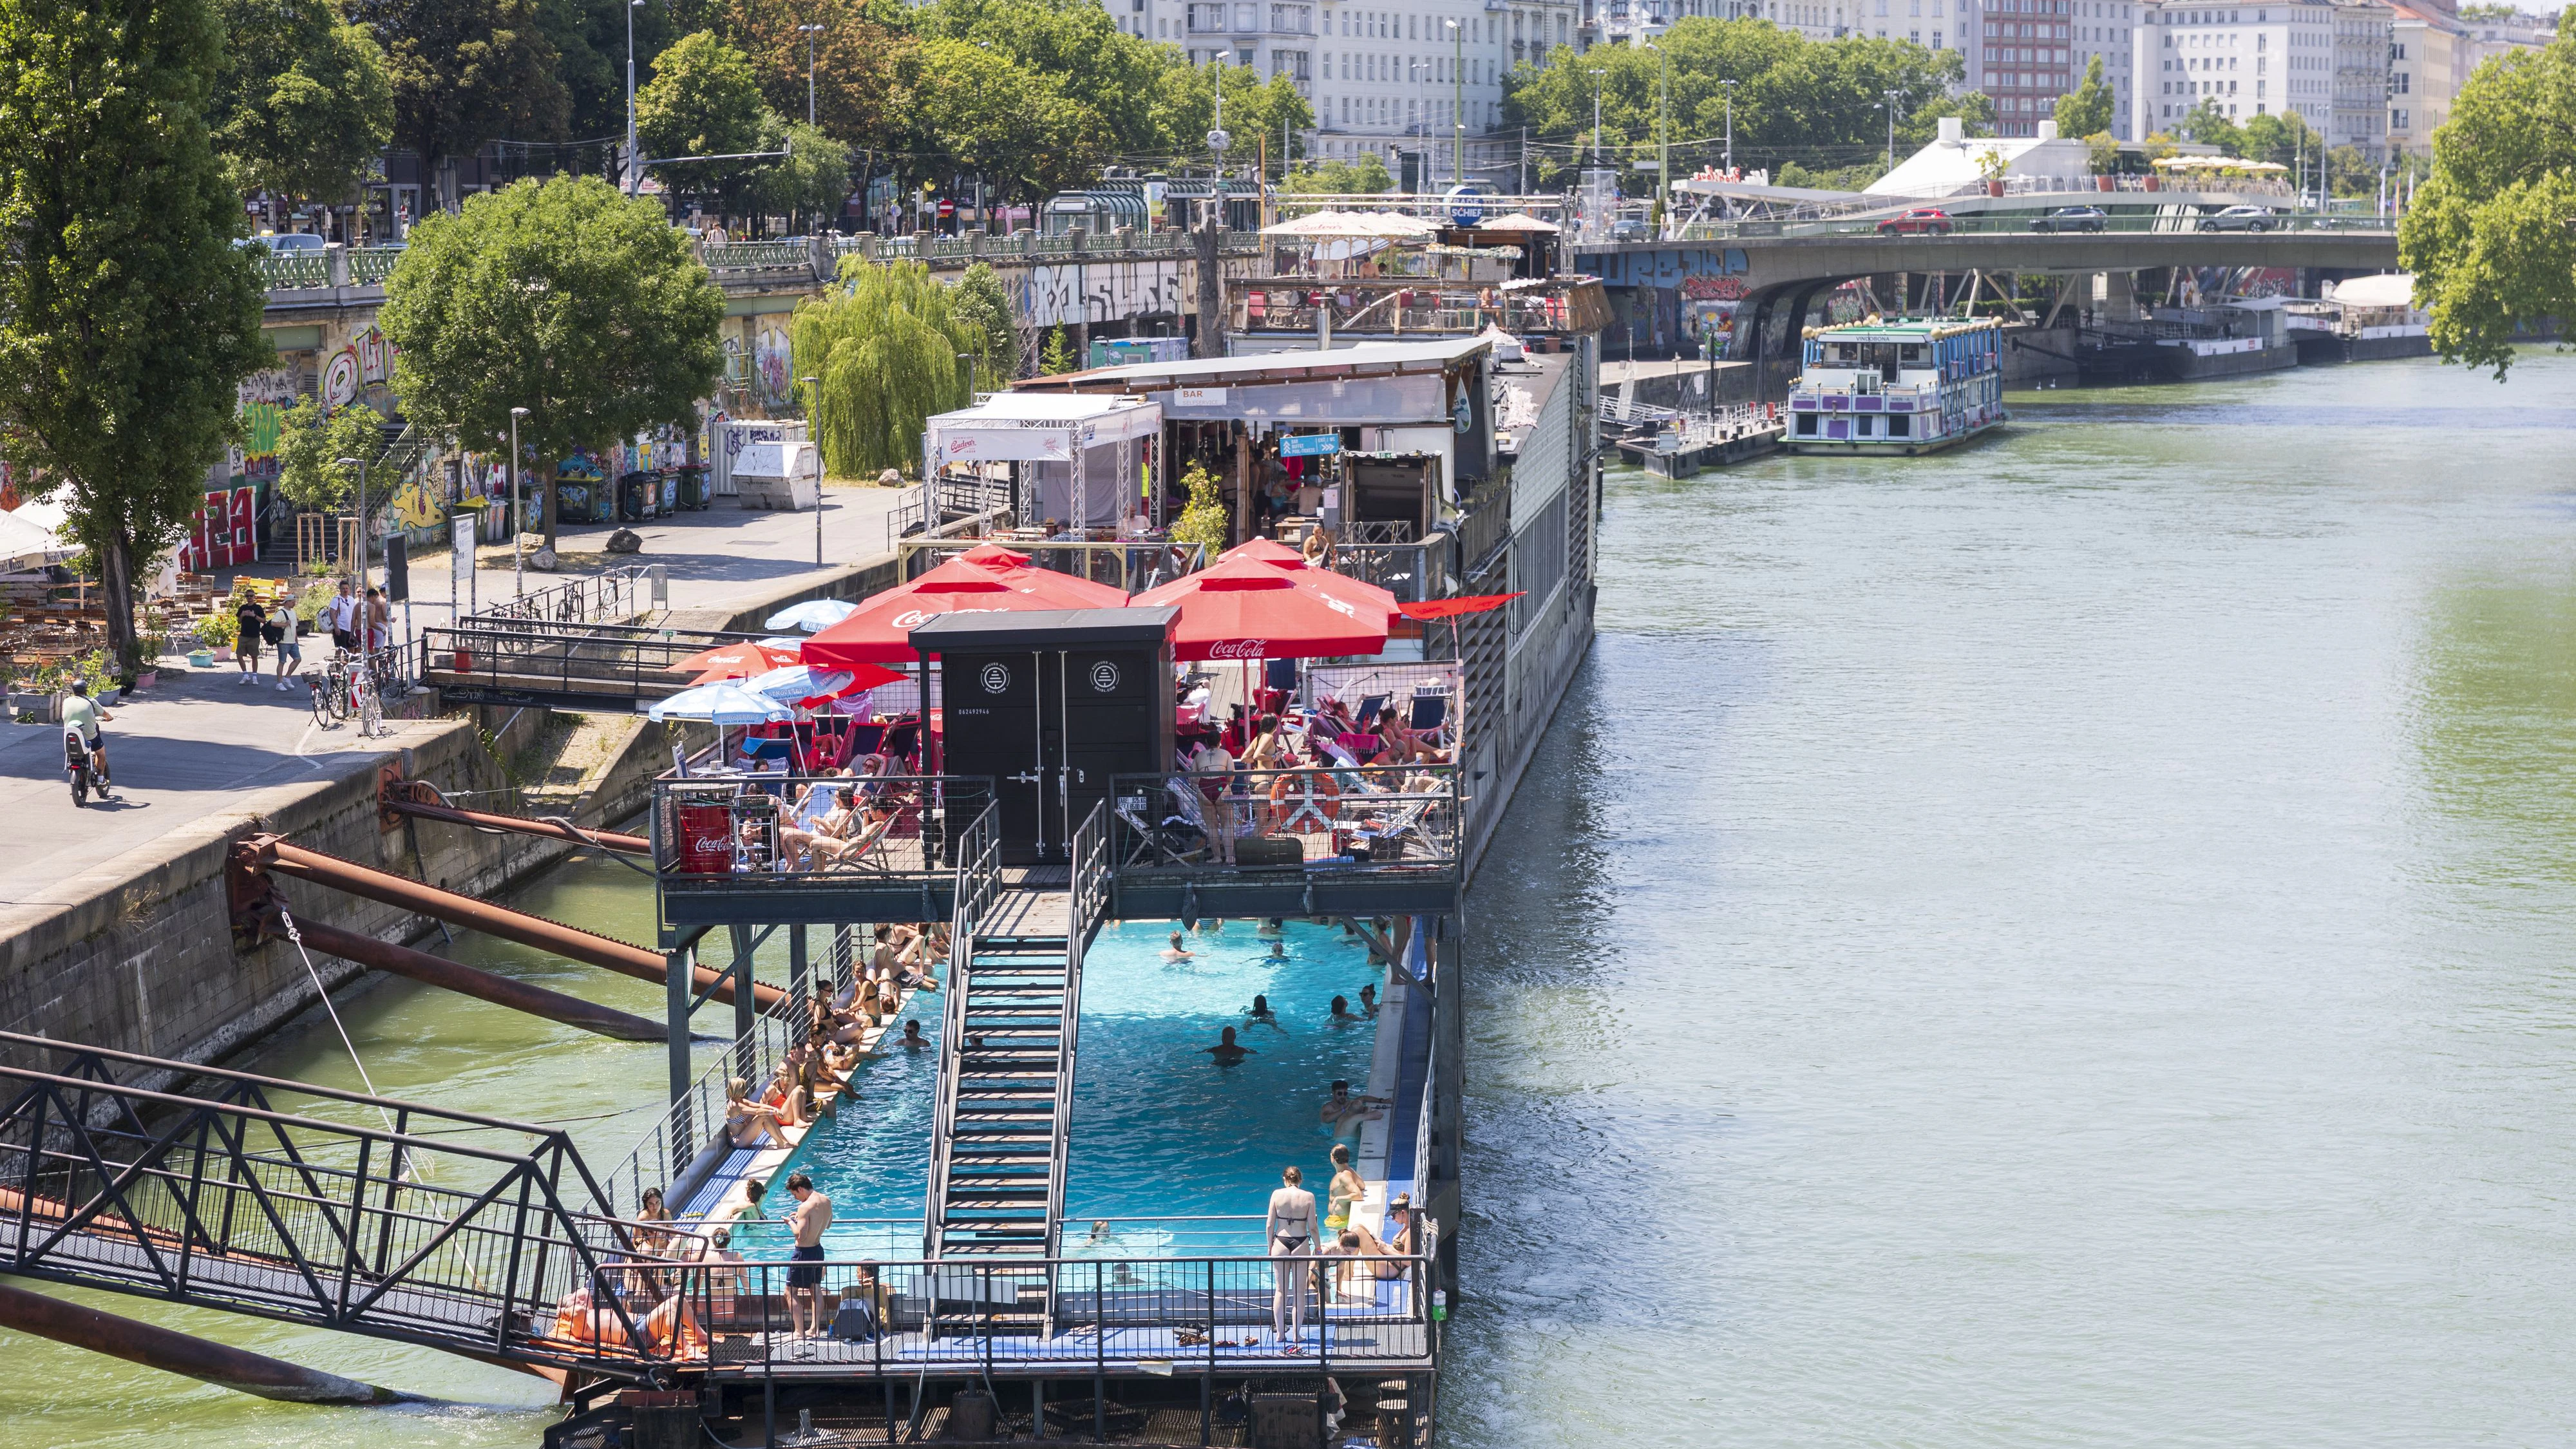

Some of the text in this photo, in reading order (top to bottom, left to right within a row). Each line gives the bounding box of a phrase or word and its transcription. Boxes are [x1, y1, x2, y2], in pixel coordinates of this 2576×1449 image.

[1209, 639, 1266, 658] Coca-Cola
[981, 662, 999, 672] AUFGUSS
[1091, 661, 1108, 670] AUFGUSS
[696, 835, 732, 852] Coca-Cola
